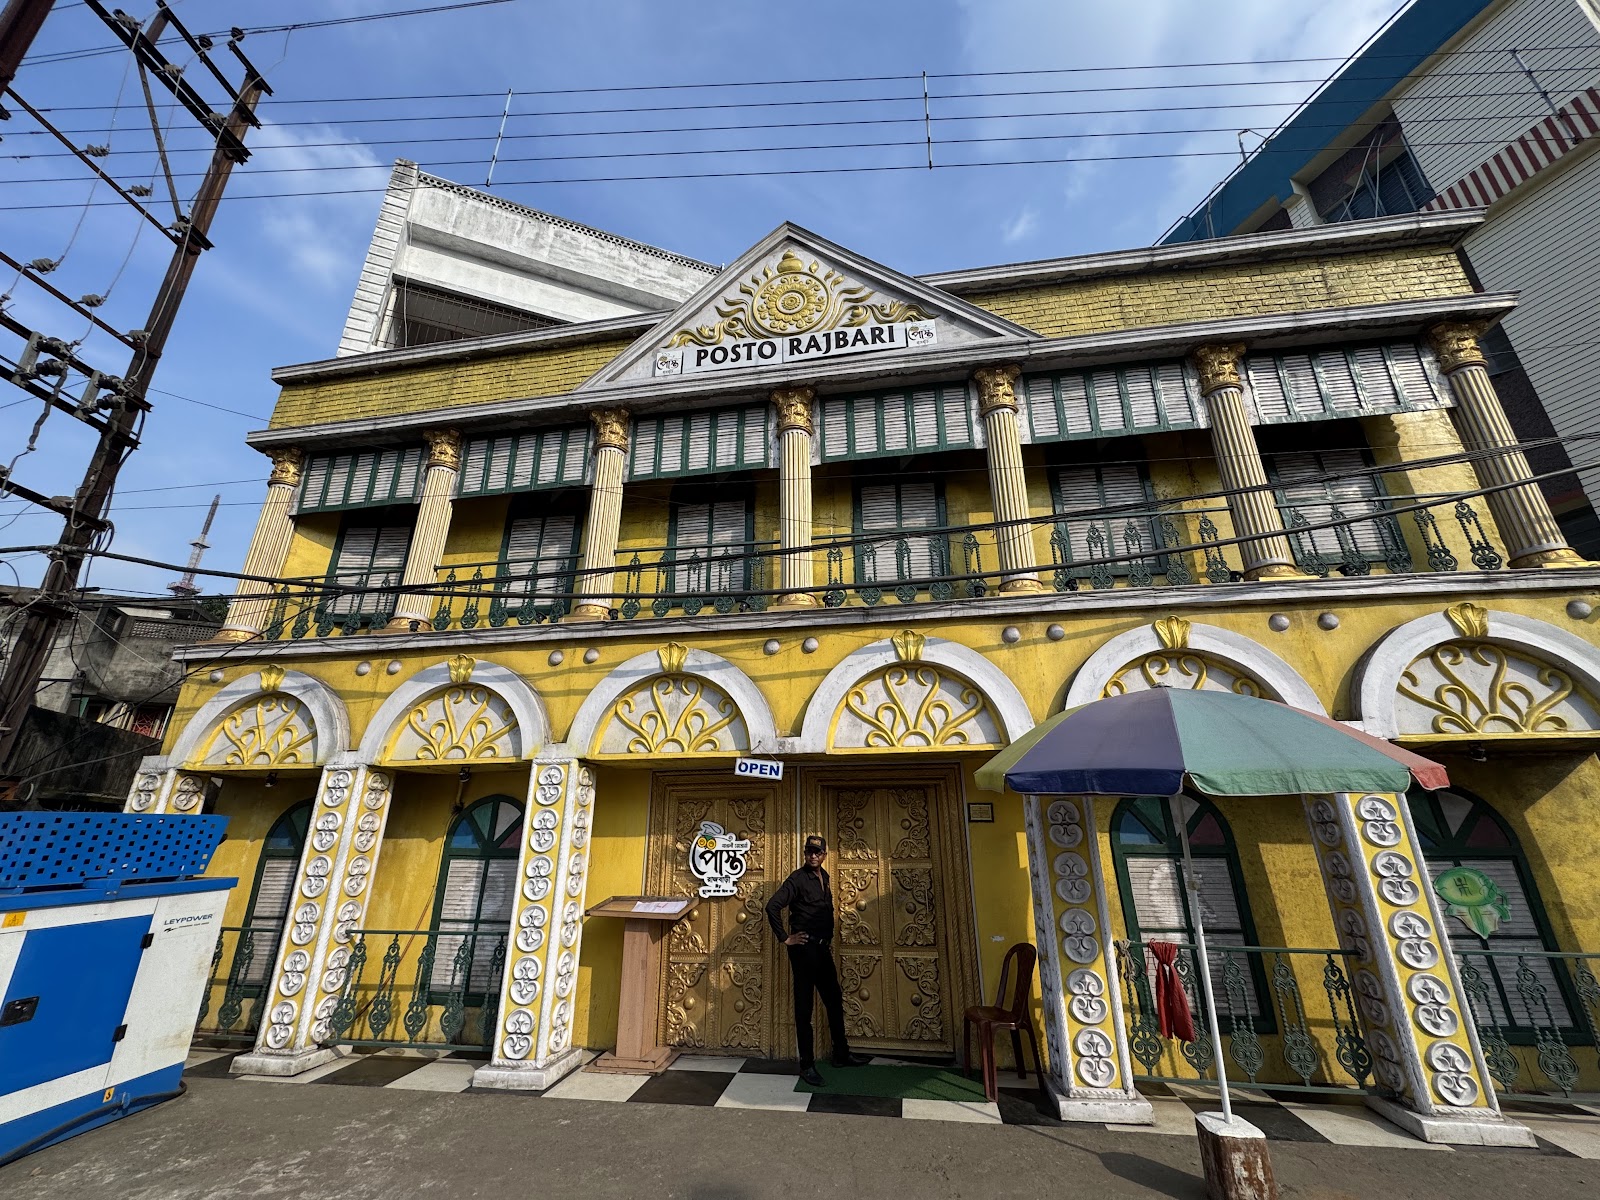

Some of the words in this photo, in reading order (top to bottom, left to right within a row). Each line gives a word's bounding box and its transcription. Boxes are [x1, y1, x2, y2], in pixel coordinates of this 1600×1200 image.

[695, 340, 777, 367] POSTO
[788, 325, 896, 356] RAJBARI
[738, 762, 780, 776] OPEN
[164, 914, 213, 925] LEYPOWER
